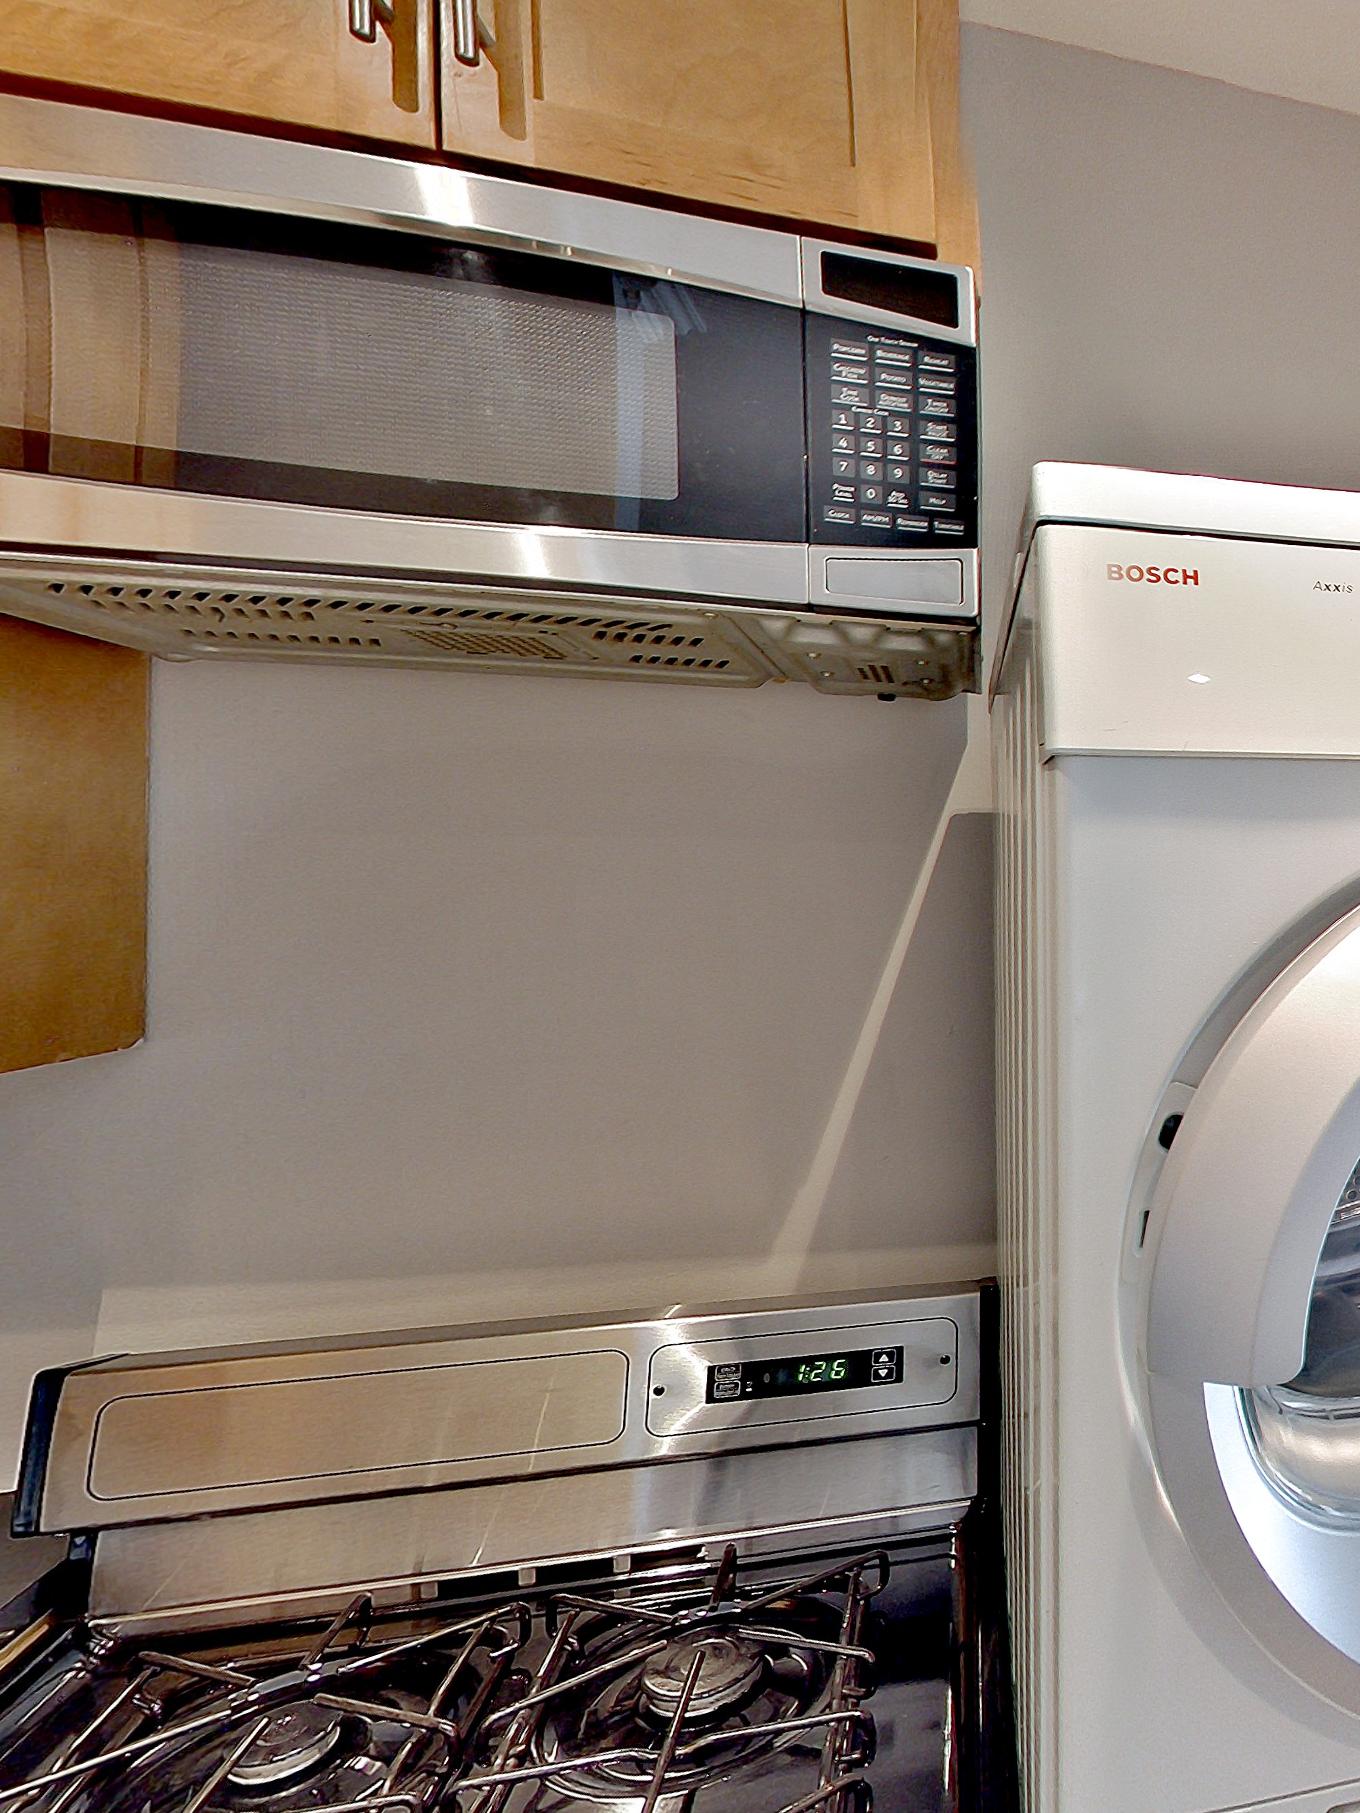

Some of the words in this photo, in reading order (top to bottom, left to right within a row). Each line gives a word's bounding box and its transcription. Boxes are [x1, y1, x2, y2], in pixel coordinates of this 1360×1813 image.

[838, 413, 848, 425] 1
[866, 417, 876, 428] 2
[893, 420, 902, 432] 3
[838, 437, 848, 448] 4
[866, 440, 876, 452] 5
[893, 444, 903, 455] 6
[839, 461, 848, 472] 7
[866, 464, 876, 475] 8
[893, 467, 903, 478] 9
[866, 488, 876, 499] 0
[1106, 563, 1200, 586] BOSCH
[1312, 580, 1354, 595] Axxis
[797, 1359, 847, 1383] 1:26
